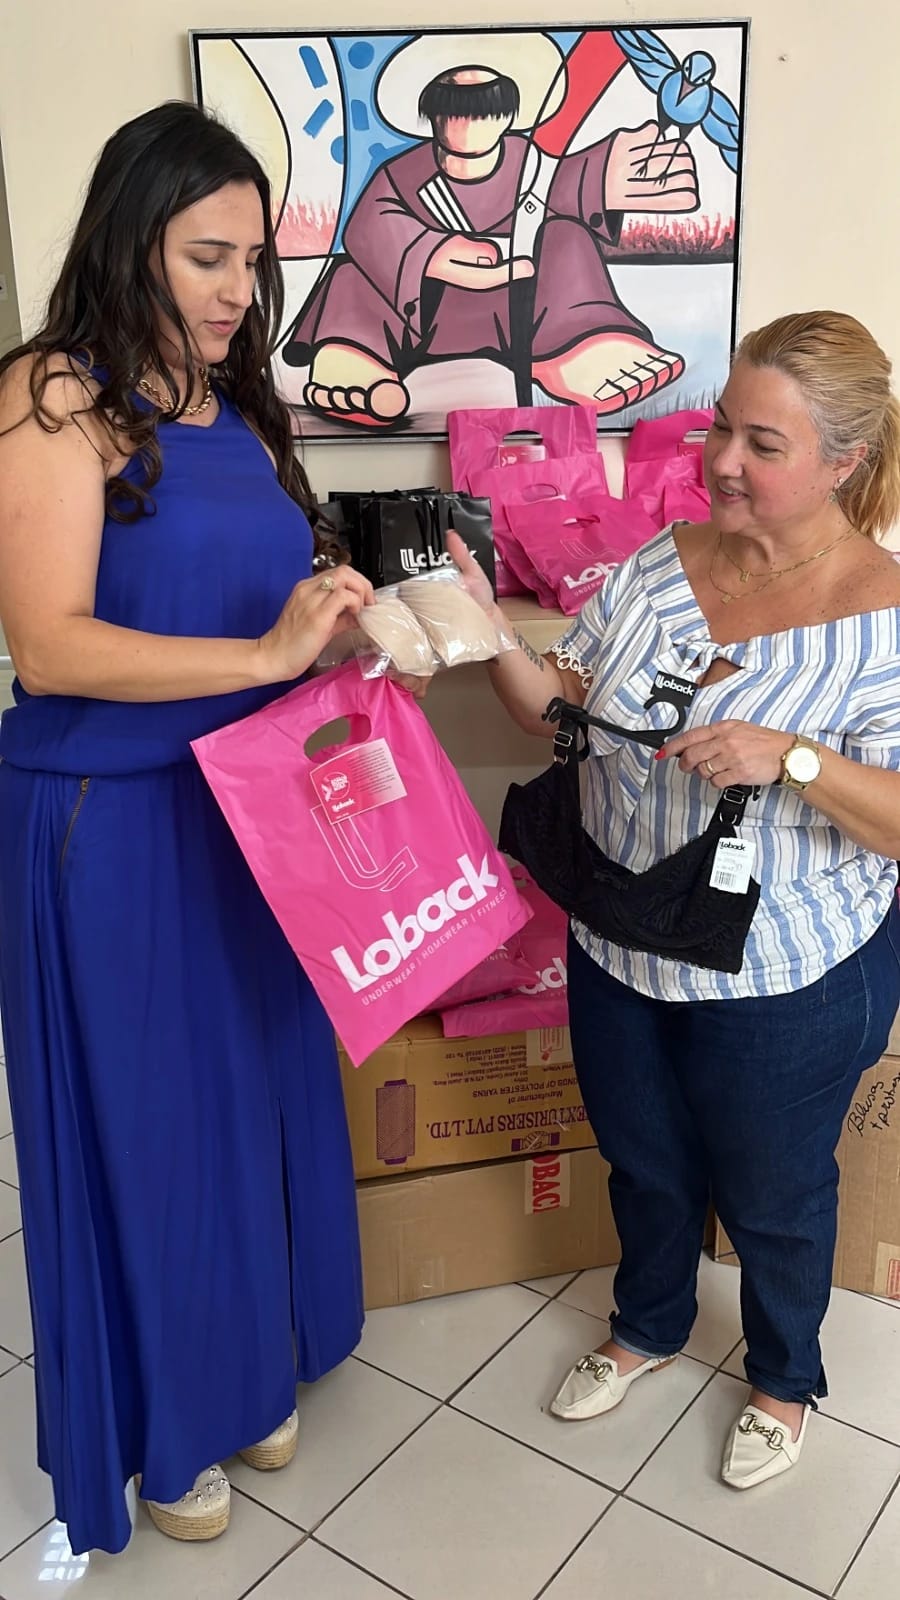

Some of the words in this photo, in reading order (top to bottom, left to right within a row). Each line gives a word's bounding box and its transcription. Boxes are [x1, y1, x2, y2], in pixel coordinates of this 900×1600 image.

[331, 853, 499, 993] Loback
[361, 963, 416, 1006] UNDERWEAR
[421, 917, 469, 960] HOMEWEAR
[477, 888, 508, 917] FITNESS
[472, 1087, 498, 1098] YARNS
[501, 1081, 545, 1095] POLYESTER
[498, 1106, 587, 1132] EXTURISERS
